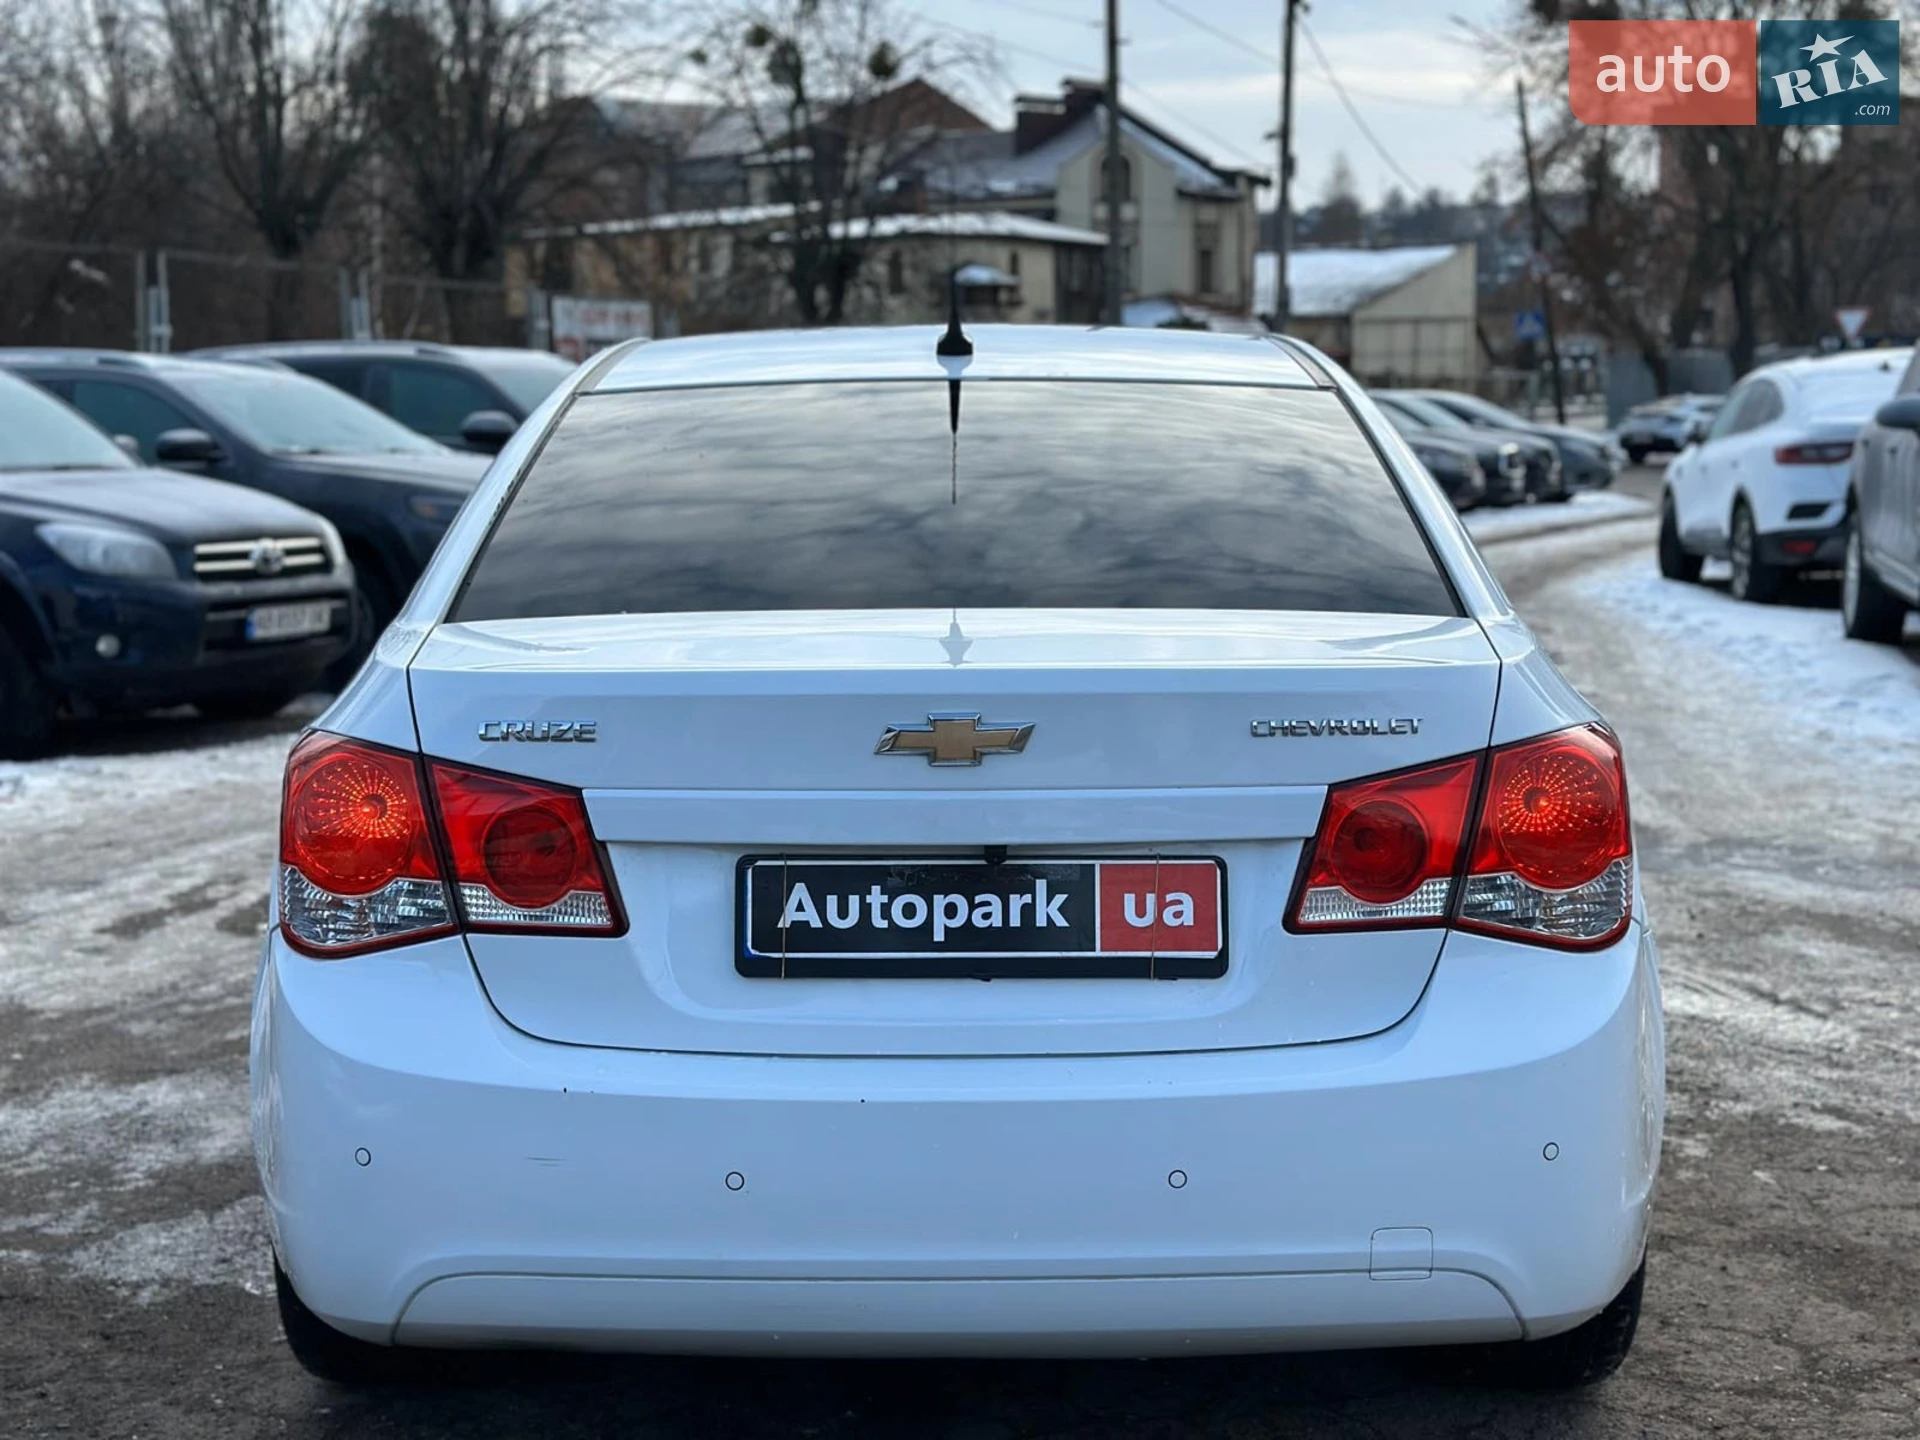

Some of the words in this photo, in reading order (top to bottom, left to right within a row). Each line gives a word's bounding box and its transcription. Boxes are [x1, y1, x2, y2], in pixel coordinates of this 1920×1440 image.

[478, 720, 597, 743] CRUZE
[1250, 717, 1423, 738] CHEVROLET
[777, 878, 1070, 942] Autopark
[1123, 891, 1195, 927] ua
